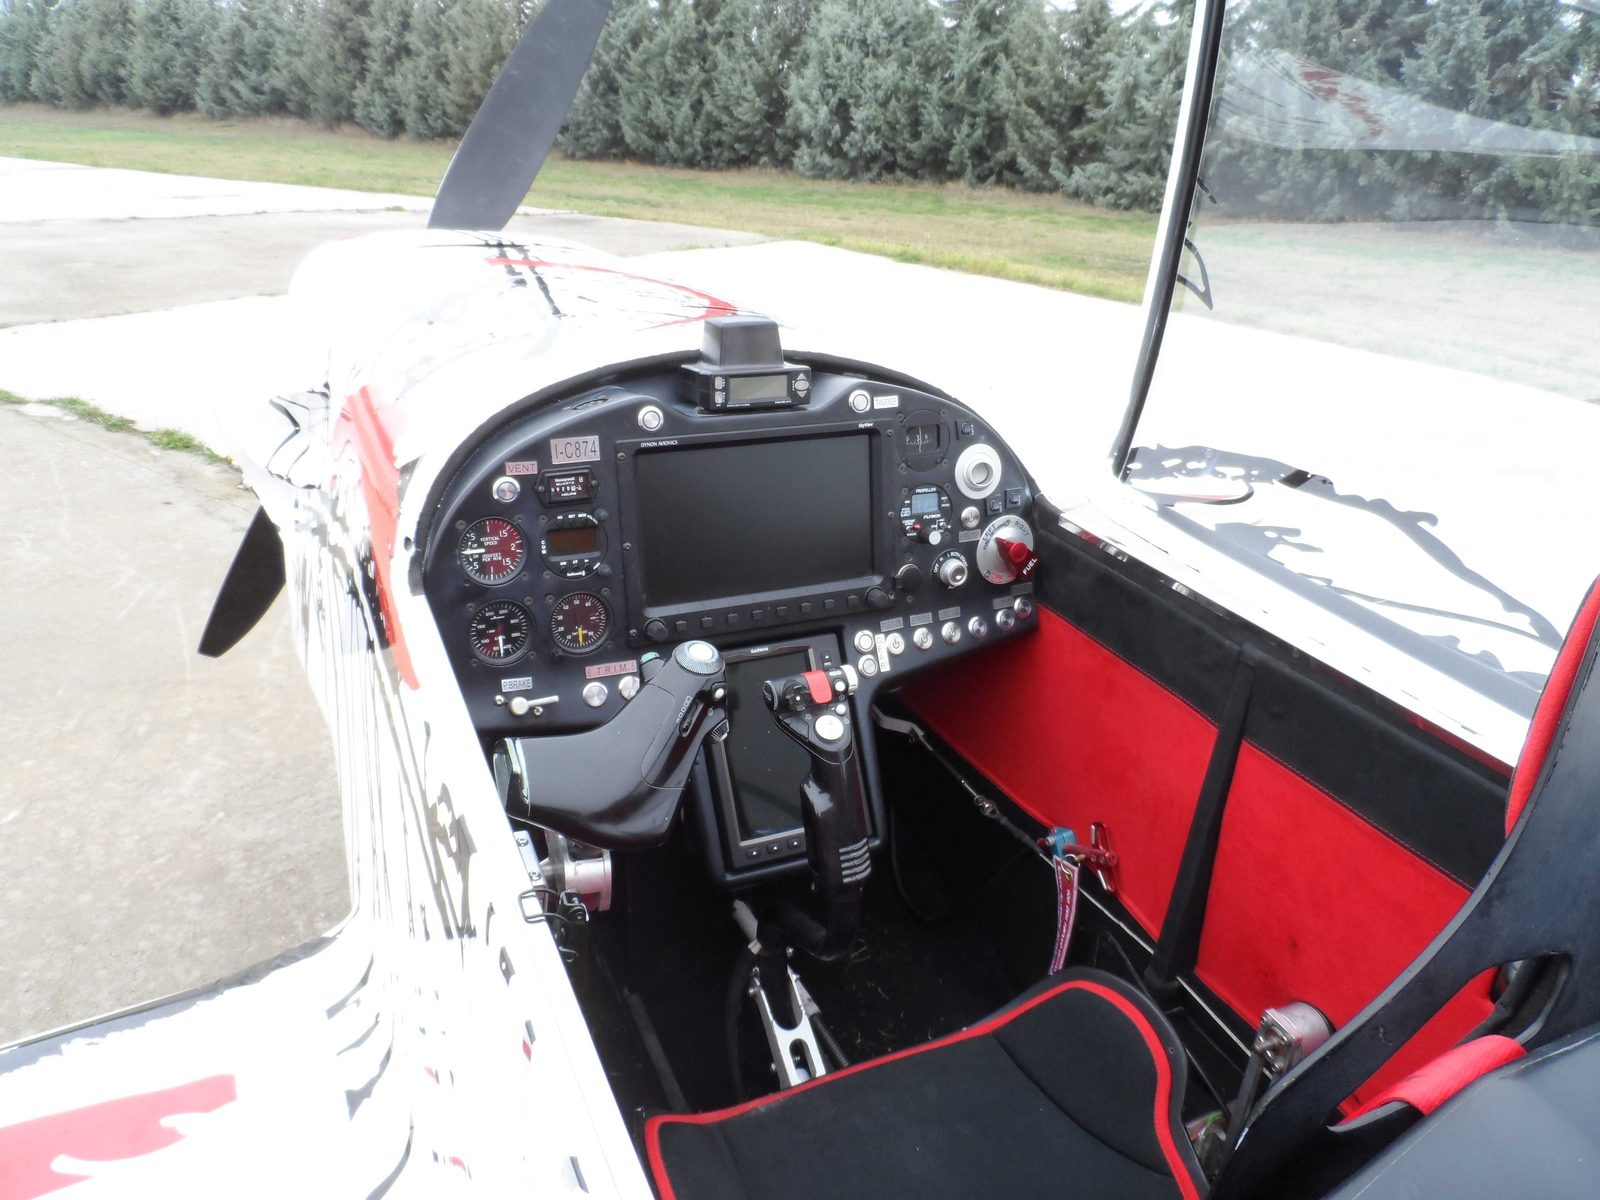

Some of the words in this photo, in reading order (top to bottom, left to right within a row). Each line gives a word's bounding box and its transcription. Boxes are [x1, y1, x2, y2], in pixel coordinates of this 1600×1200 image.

[554, 440, 598, 460] I-C874
[507, 463, 536, 474] VENT
[510, 543, 516, 551] 2
[1022, 558, 1038, 575] FUEL
[596, 663, 627, 676] TRIM
